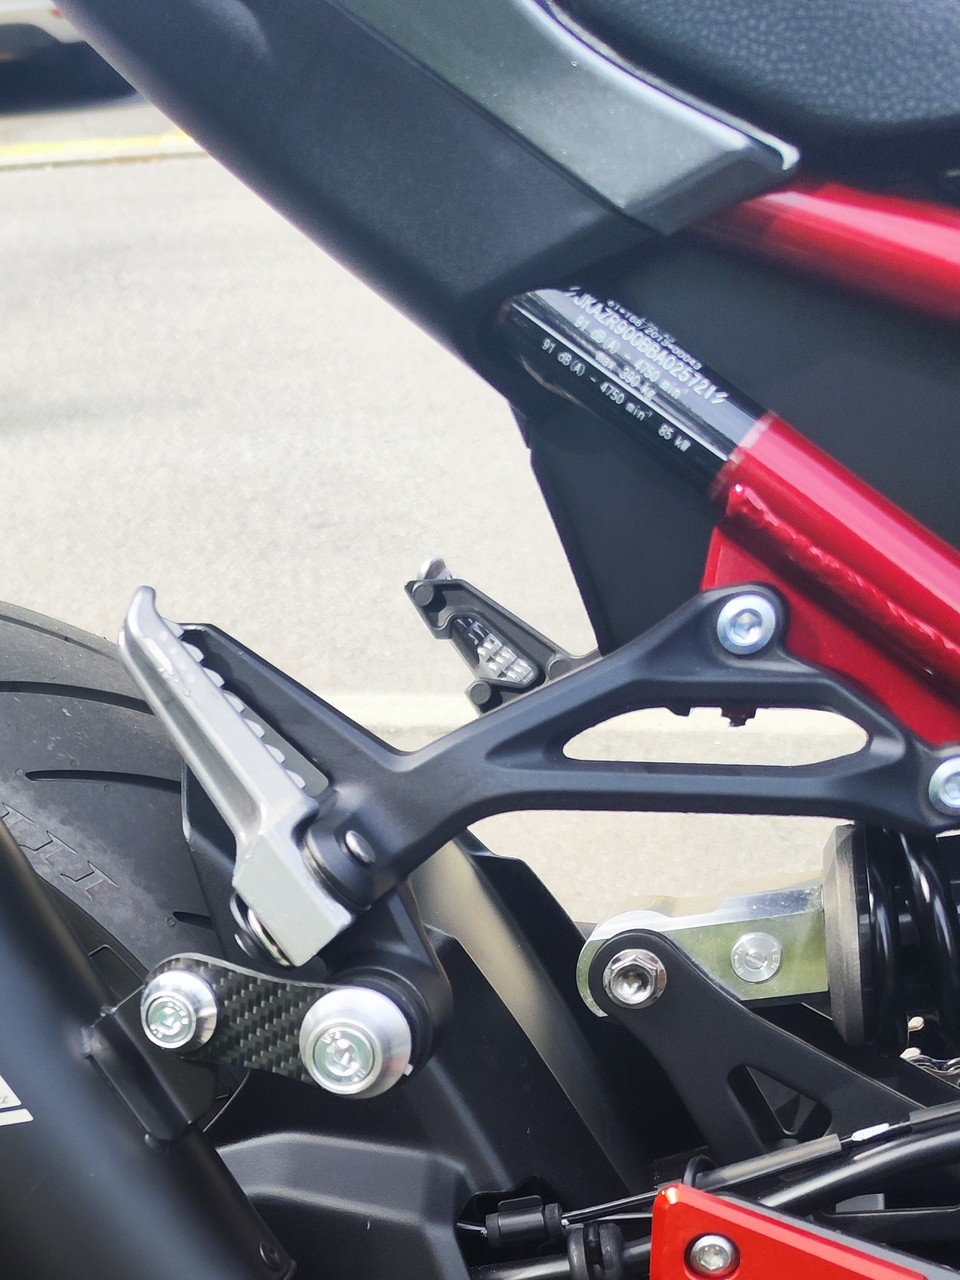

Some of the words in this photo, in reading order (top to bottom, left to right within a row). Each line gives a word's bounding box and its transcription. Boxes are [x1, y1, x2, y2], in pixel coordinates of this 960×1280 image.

[574, 315, 590, 332] 91
[541, 338, 556, 354] 91
[599, 380, 626, 404] 4750
[657, 423, 674, 441] 85
